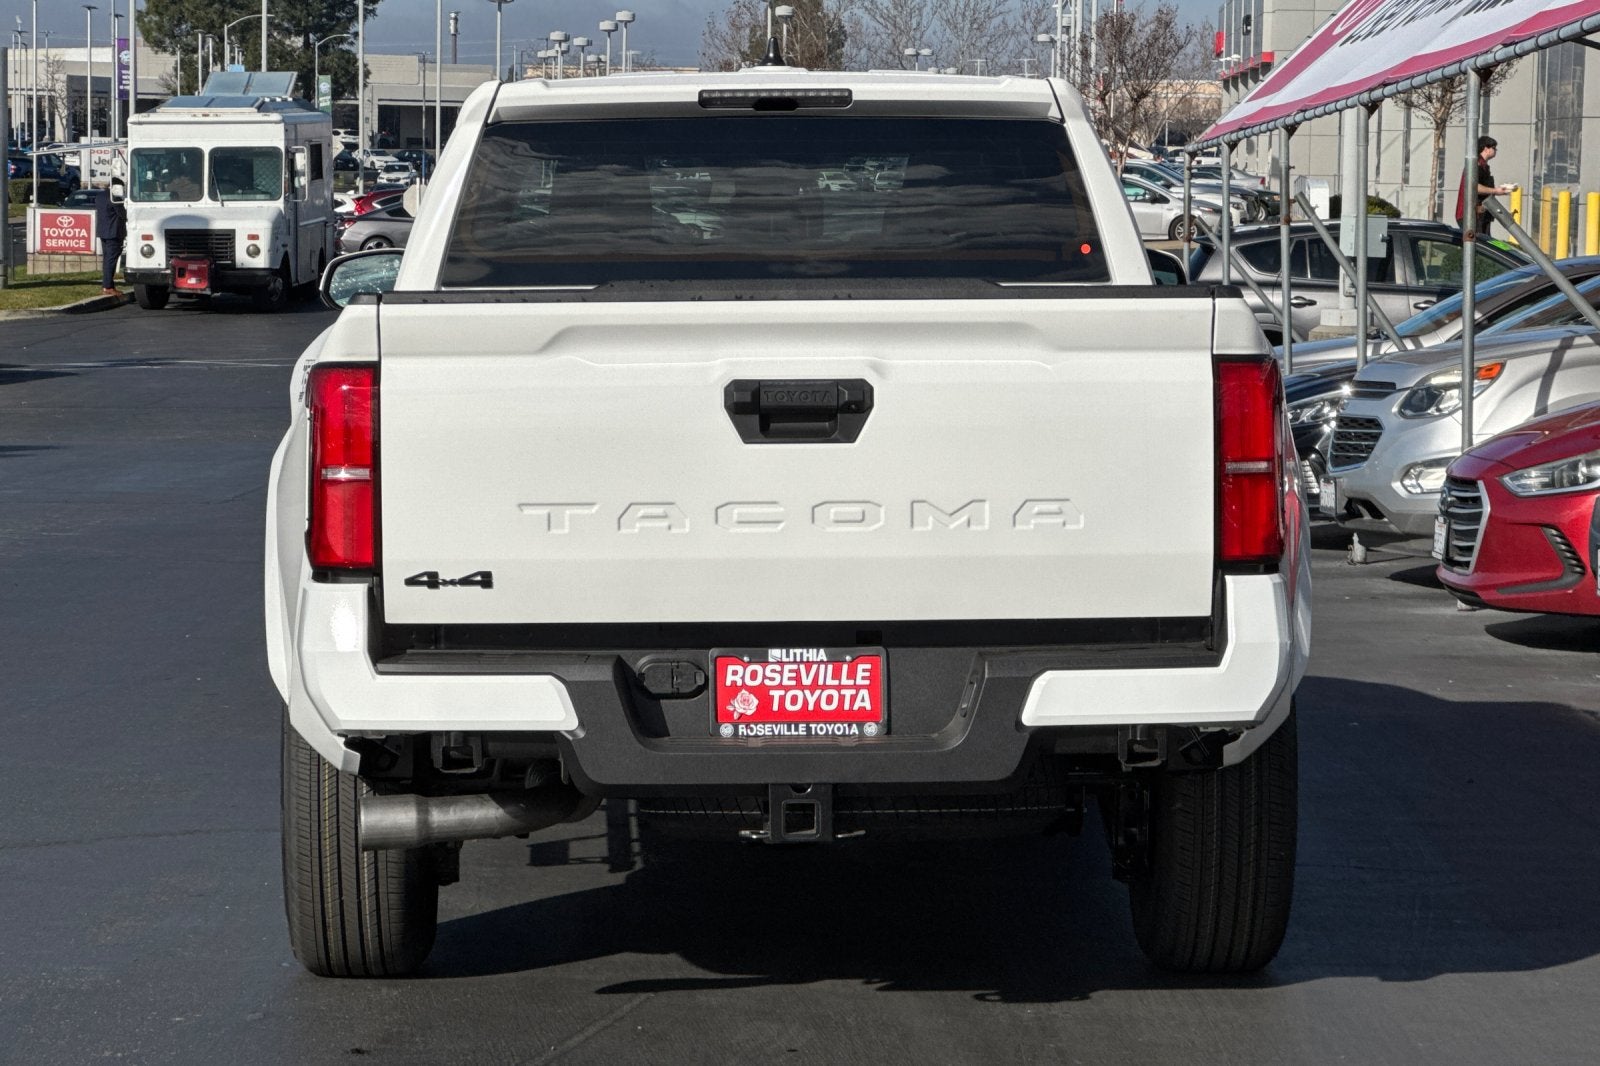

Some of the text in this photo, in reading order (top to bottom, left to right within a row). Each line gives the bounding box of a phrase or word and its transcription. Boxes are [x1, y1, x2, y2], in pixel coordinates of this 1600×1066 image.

[43, 227, 88, 238] TOYOTA
[45, 239, 86, 248] SERVICE
[763, 390, 833, 402] TOYOTA
[517, 497, 1086, 535] TACOMA
[781, 648, 828, 662] LITHIA
[725, 663, 872, 687] ROSEVILLE
[768, 688, 873, 712] TOYOTA
[738, 723, 859, 736] ROSEVILLE TOYOTA
